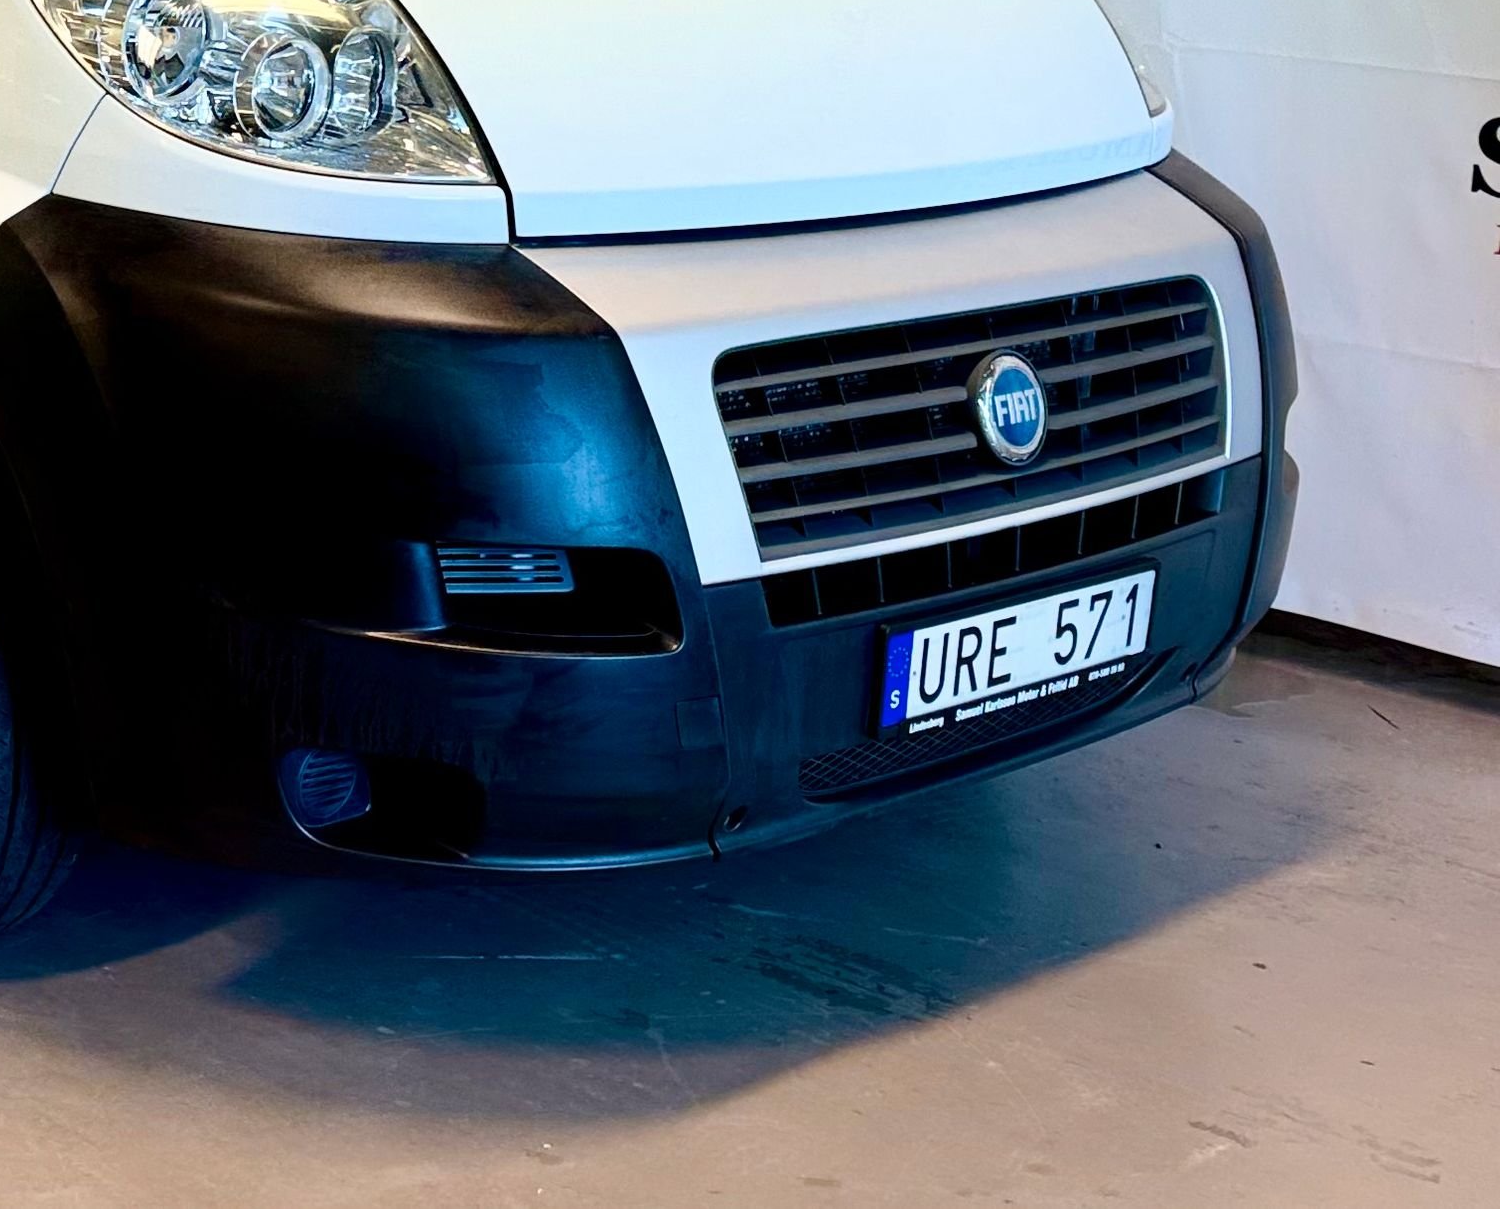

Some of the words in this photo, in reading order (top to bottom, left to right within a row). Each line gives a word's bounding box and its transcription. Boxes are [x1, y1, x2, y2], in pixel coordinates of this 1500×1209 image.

[994, 388, 1036, 427] FIAT
[889, 690, 901, 709] S
[919, 616, 1018, 704] URE
[1054, 583, 1140, 665] 571
